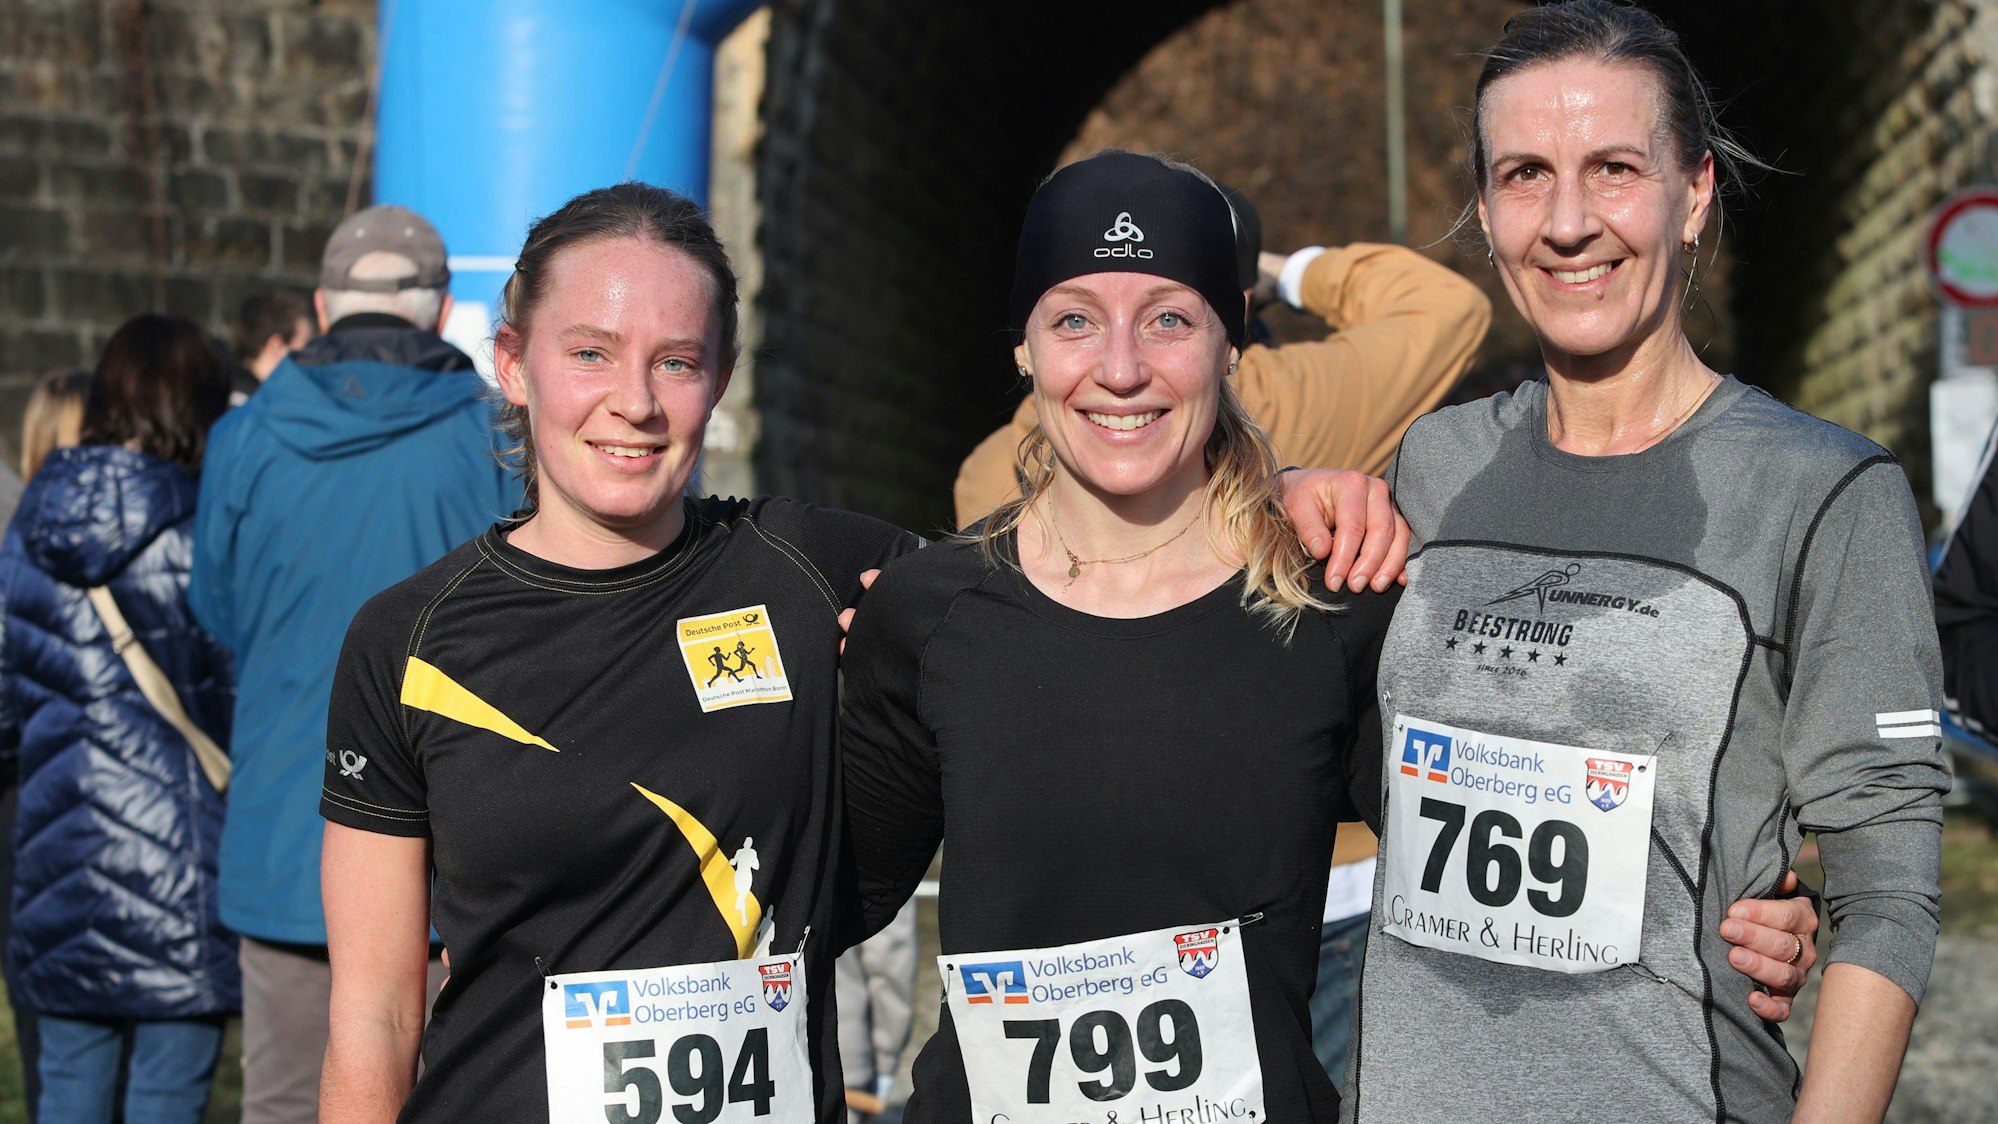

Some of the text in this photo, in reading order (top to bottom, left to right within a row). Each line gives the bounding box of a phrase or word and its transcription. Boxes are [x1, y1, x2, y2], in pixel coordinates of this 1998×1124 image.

[1094, 243, 1153, 259] odlo
[685, 620, 741, 637] Deutsche Post
[1453, 609, 1574, 647] BEESTRONG
[702, 692, 730, 702] Deutsche
[1455, 740, 1544, 773] Volksbank
[1594, 760, 1624, 773] TSV
[1451, 767, 1572, 804] Oberberg eG
[1419, 796, 1590, 918] 769
[1182, 931, 1210, 943] TSV
[1391, 894, 1470, 943] CRAMER
[1480, 916, 1500, 948] &
[764, 964, 785, 975] TSV
[1028, 946, 1136, 978] Volksbank
[633, 972, 731, 998] Volksbank
[1032, 966, 1168, 1003] Oberberg eG
[634, 995, 755, 1023] Oberberg eG
[1002, 999, 1203, 1104] 799
[603, 1027, 775, 1124] 594
